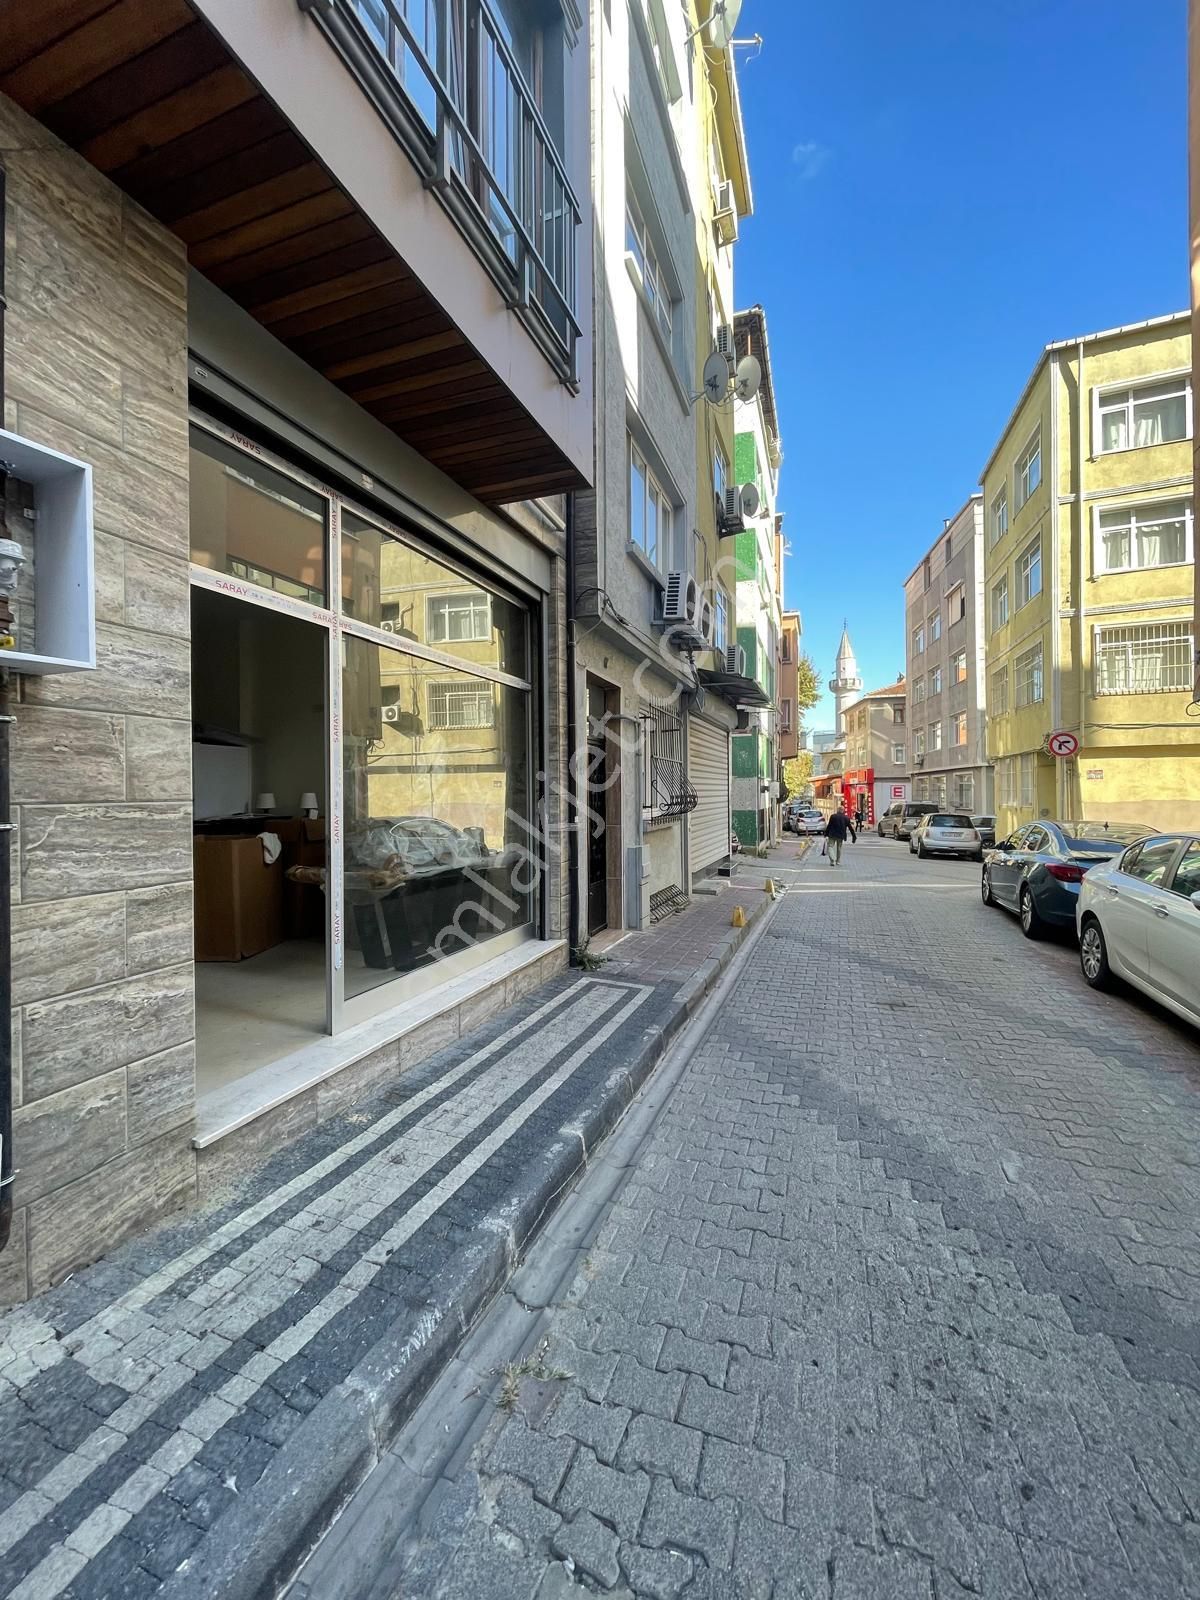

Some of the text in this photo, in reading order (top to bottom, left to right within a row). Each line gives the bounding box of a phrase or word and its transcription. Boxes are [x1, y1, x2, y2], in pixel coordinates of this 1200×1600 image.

[229, 432, 261, 455] SARAY
[215, 580, 248, 597] SARAY
[893, 787, 902, 797] E
